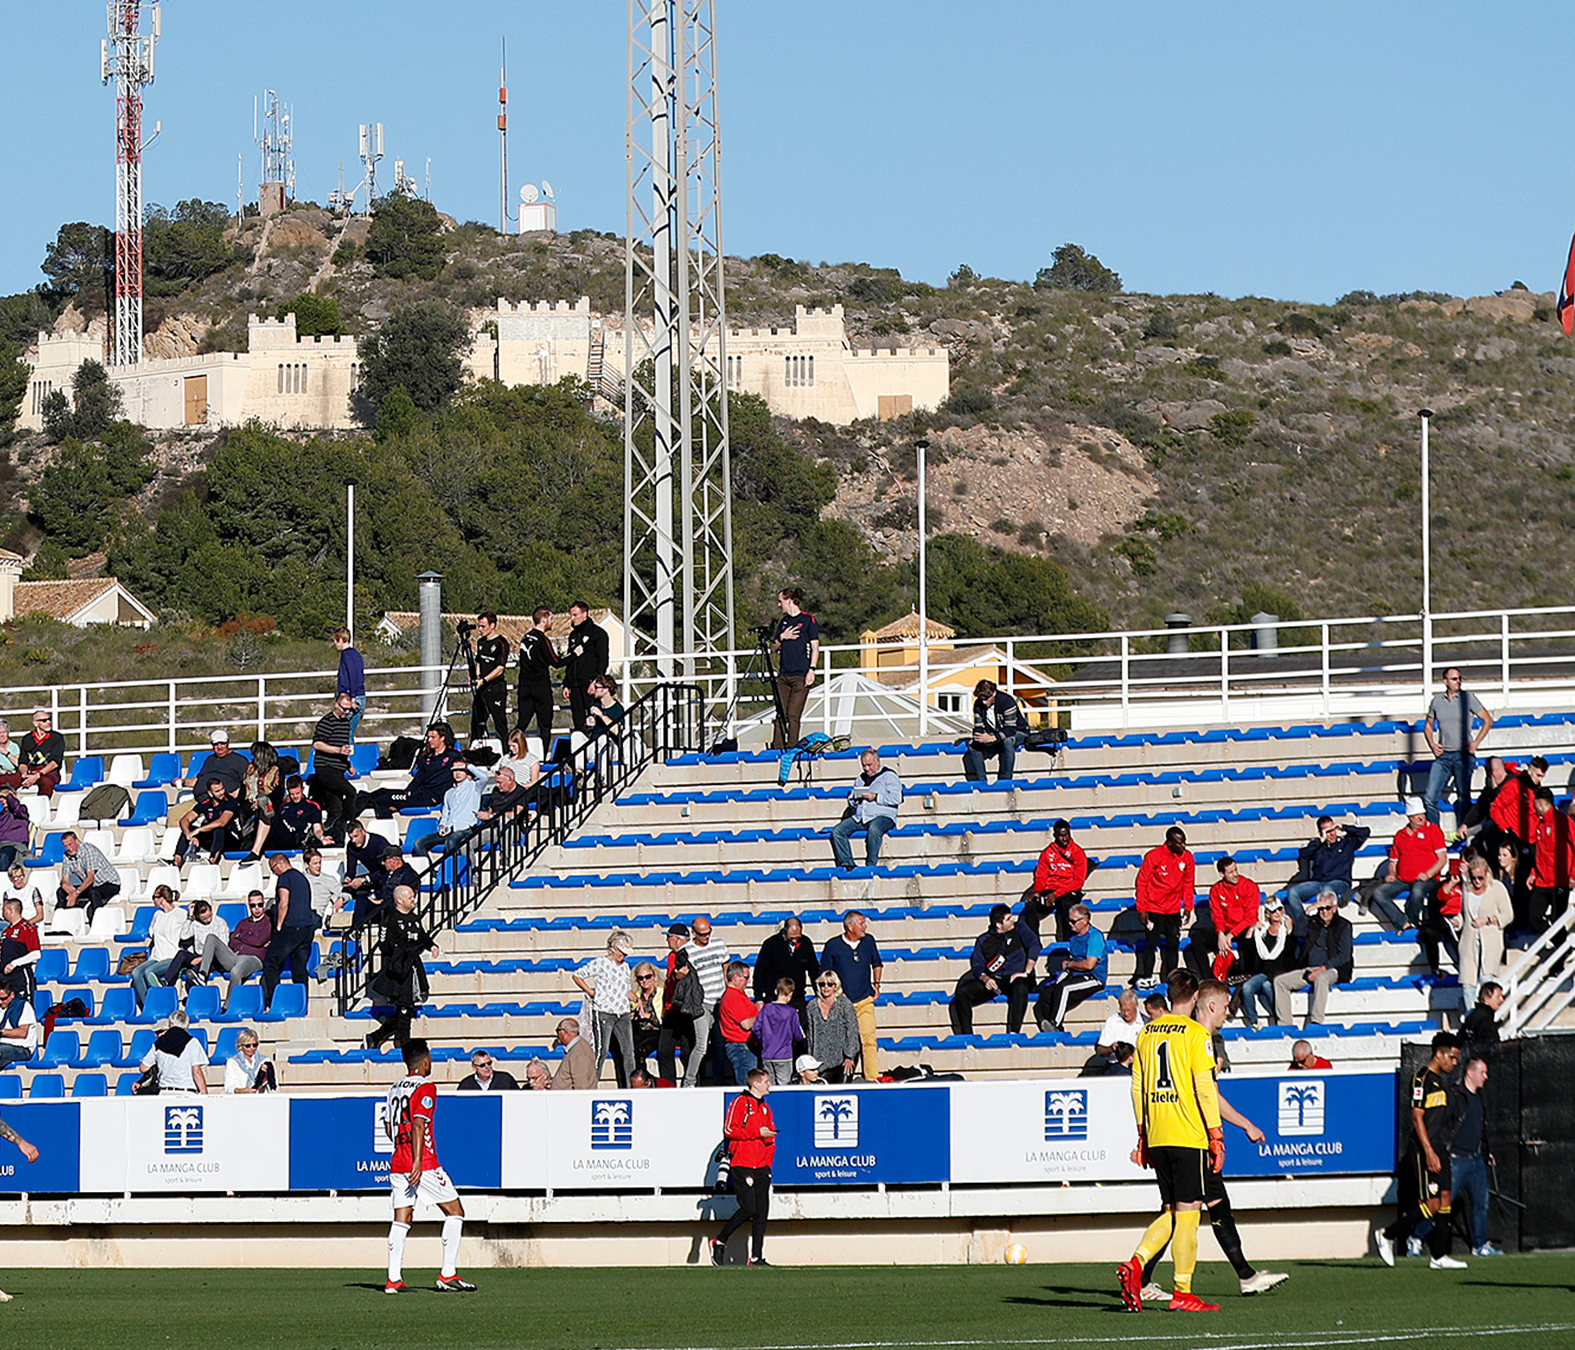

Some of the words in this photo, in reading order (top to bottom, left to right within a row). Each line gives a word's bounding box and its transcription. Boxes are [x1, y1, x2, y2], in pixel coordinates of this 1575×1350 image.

[1145, 1024, 1187, 1035] Stuttgart
[1156, 1041, 1172, 1089] 1
[1151, 1092, 1179, 1103] Zieler
[1259, 1144, 1272, 1156] LA
[1273, 1143, 1314, 1156] MANGA
[1315, 1142, 1343, 1154] CLUB
[796, 1157, 809, 1168] LA
[810, 1156, 849, 1167] MANGA
[850, 1155, 876, 1166] CLUB
[1026, 1152, 1038, 1162] LA
[1039, 1151, 1078, 1162] MANGA
[1080, 1150, 1106, 1161] CLUB
[147, 1164, 158, 1174] LA
[159, 1163, 195, 1173] MANGA
[196, 1162, 220, 1173] CLUB
[357, 1161, 369, 1172] LA
[370, 1161, 391, 1172] MAN
[573, 1160, 584, 1169] LA
[586, 1159, 624, 1169] MANGA
[625, 1159, 650, 1169] CLUB
[1278, 1159, 1295, 1168] sport
[1302, 1158, 1323, 1166] leisure
[374, 1175, 389, 1183] sport
[815, 1171, 831, 1180] sport
[837, 1170, 857, 1178] leisure
